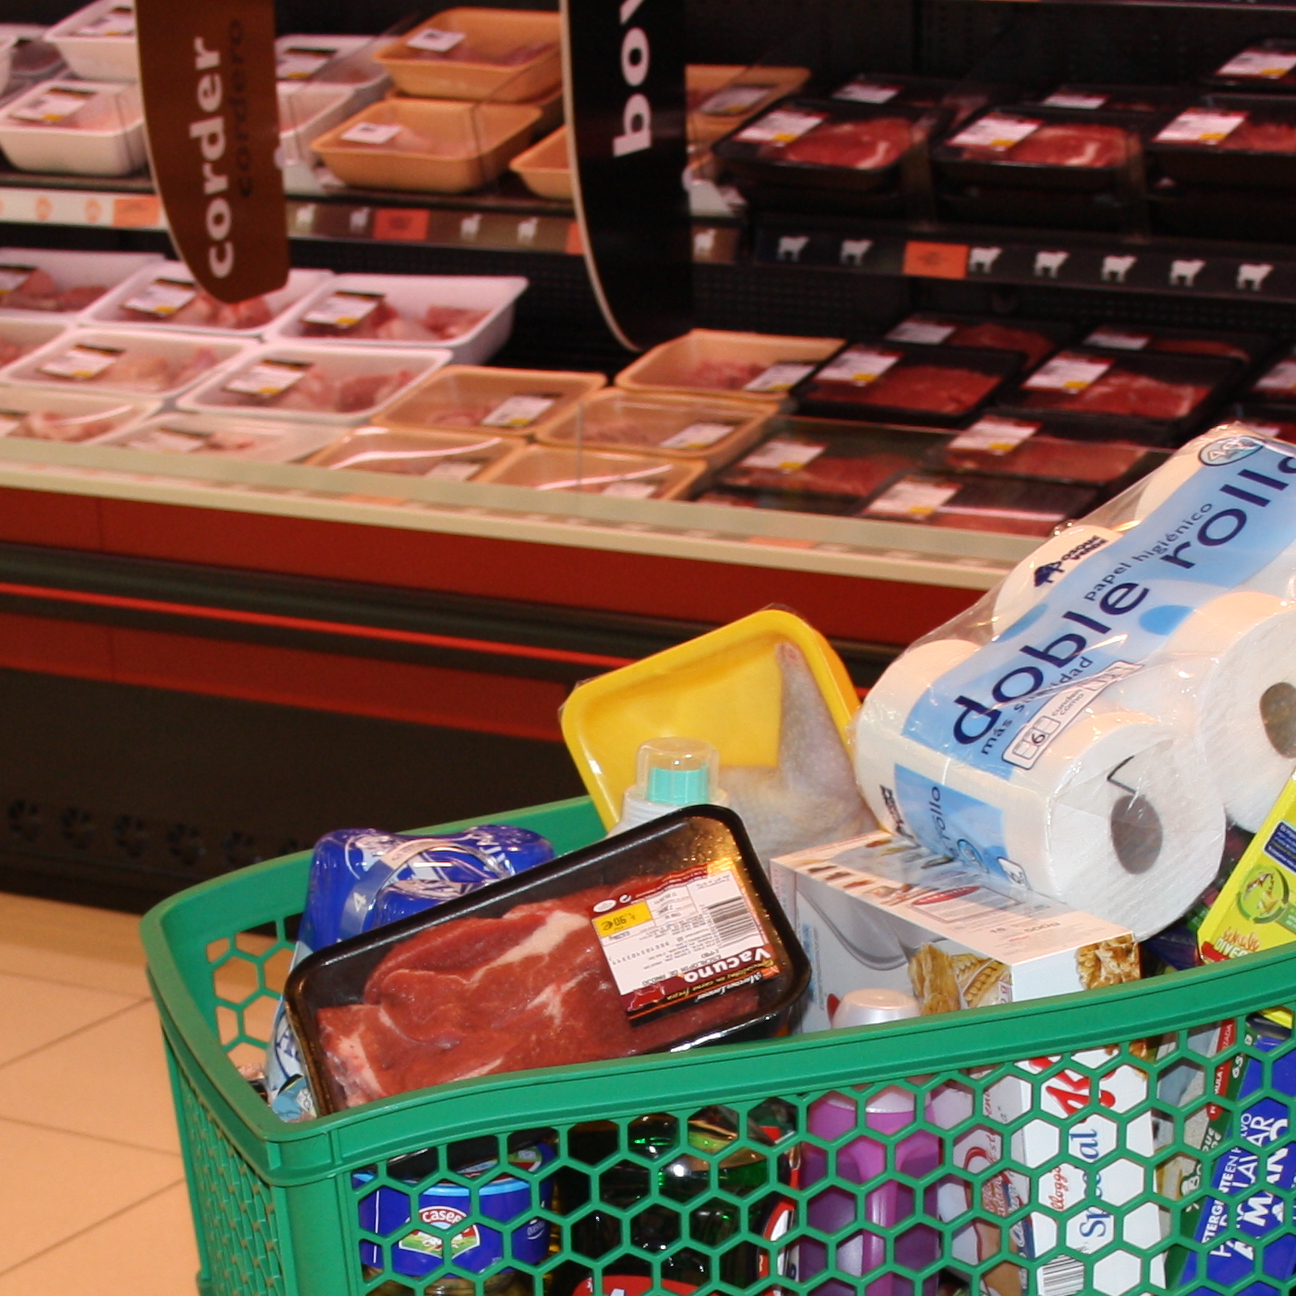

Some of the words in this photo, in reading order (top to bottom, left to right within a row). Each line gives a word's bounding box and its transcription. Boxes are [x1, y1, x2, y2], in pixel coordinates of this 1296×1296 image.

[189, 36, 235, 279] corder
[1084, 562, 1132, 602] papel
[1133, 502, 1213, 563] higiénico
[953, 581, 1150, 745] doble
[981, 719, 1013, 755] más
[1031, 732, 1046, 745] 6
[353, 892, 367, 912] 4
[684, 947, 771, 984] Vacuno
